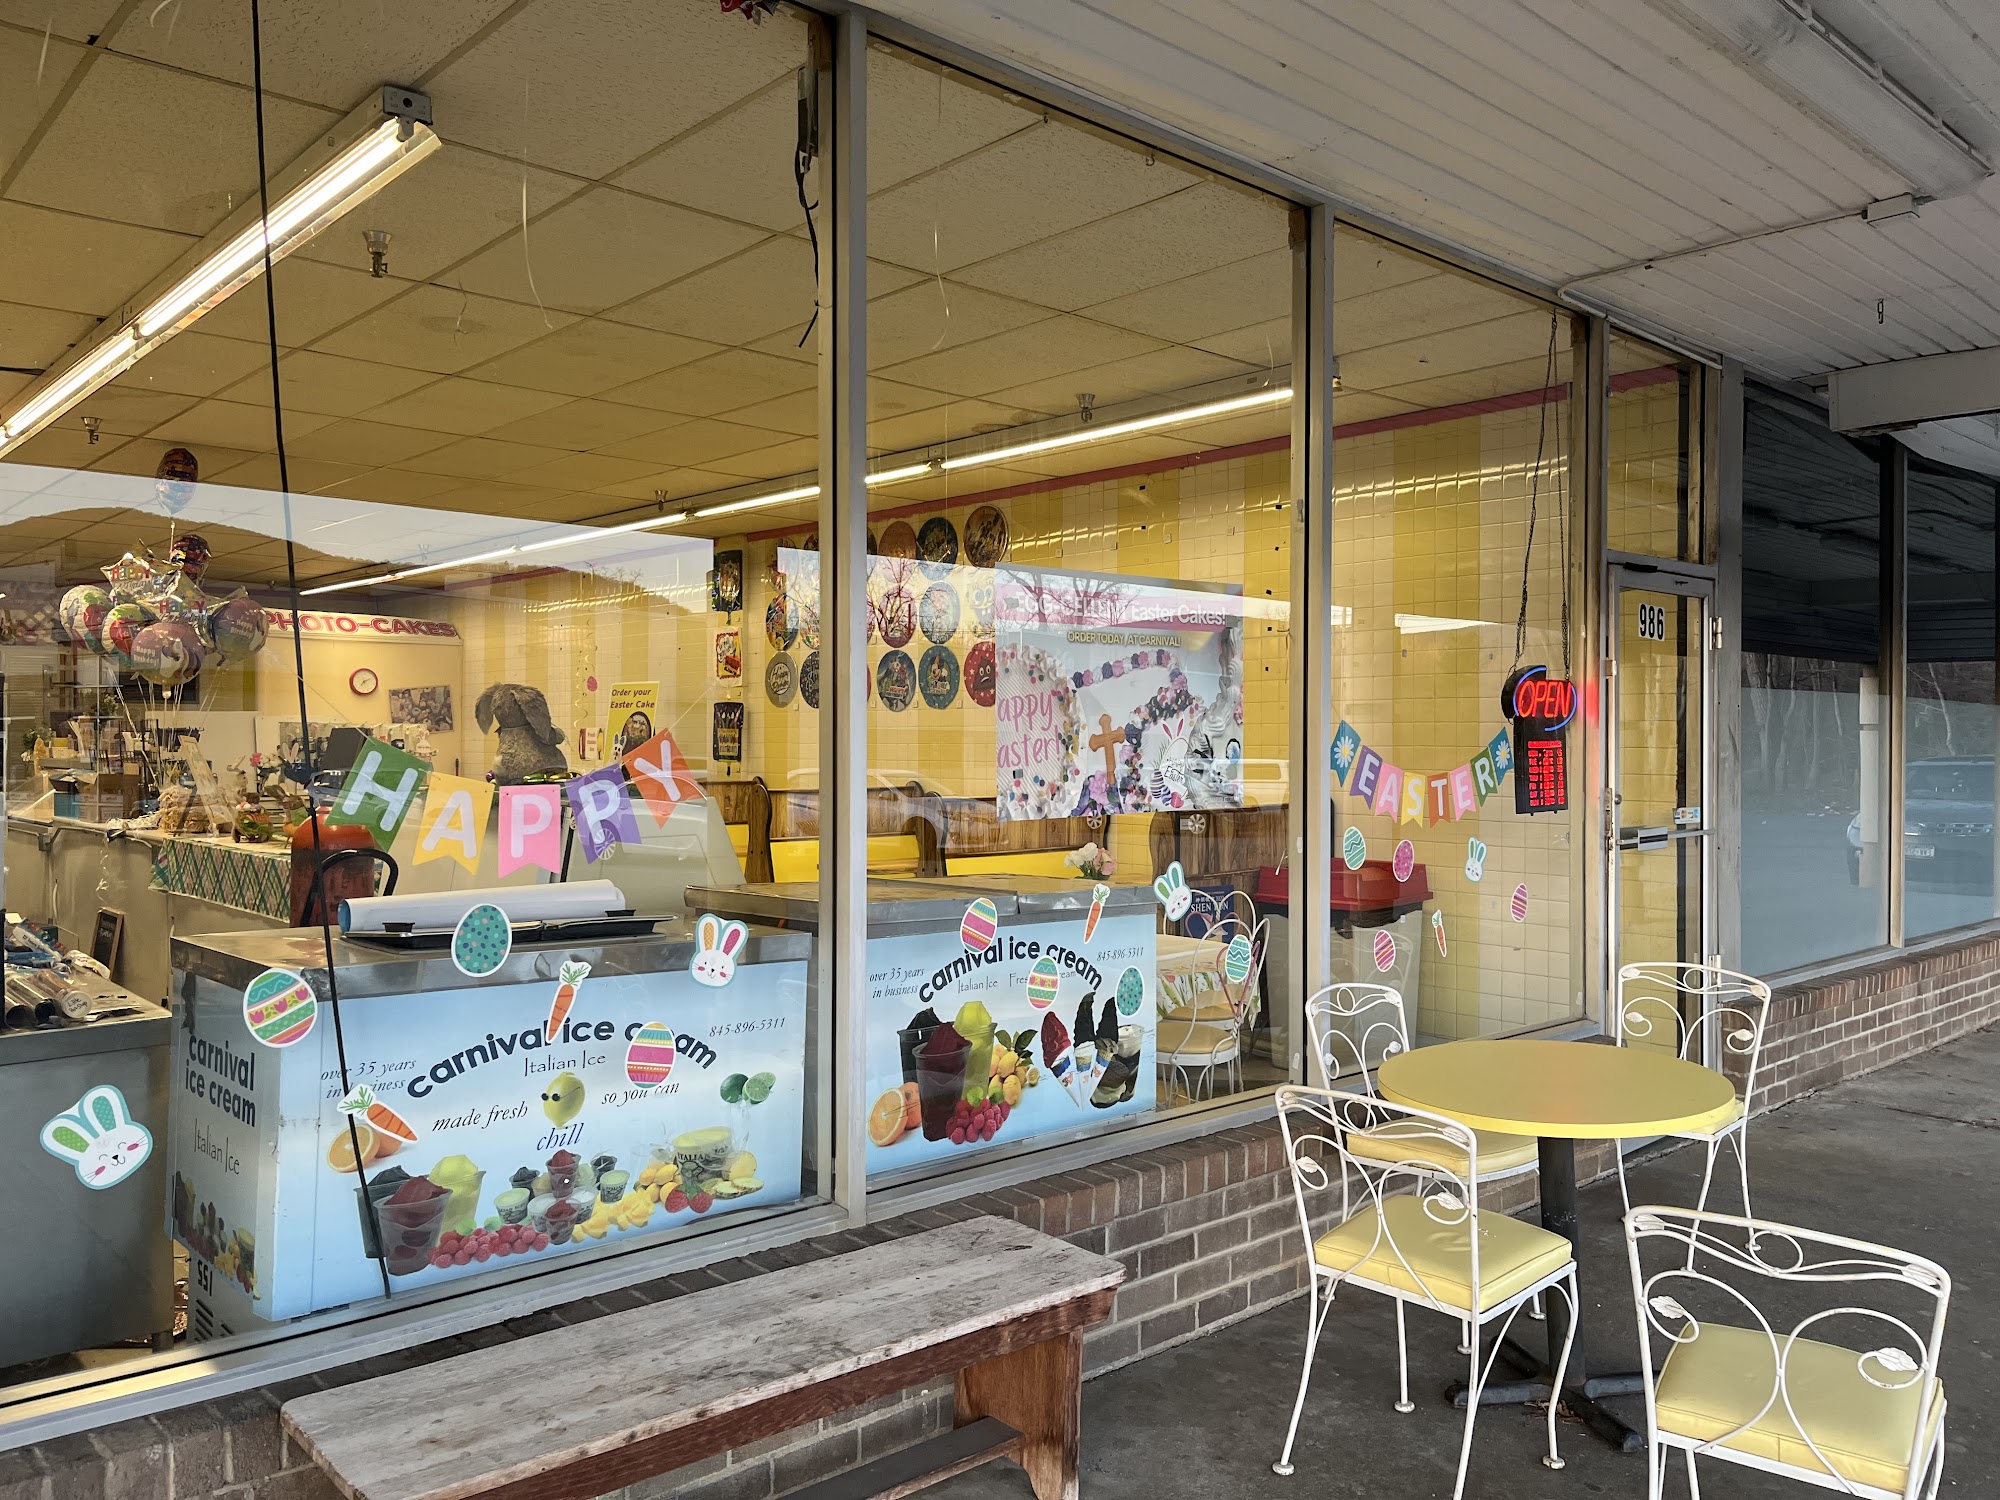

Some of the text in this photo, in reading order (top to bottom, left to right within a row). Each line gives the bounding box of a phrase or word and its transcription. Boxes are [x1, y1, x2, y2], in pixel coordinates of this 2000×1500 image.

[266, 610, 457, 638] PHOTO-CAKES
[1131, 603, 1176, 623] Easter
[1177, 604, 1227, 626] Cakes!
[1639, 603, 1665, 639] 986
[1067, 630, 1182, 647] ORDER TODAY, AT CARNIVAL!
[610, 701, 655, 709] Easter Cake
[611, 689, 652, 700] Order your
[1518, 680, 1573, 718] OPEN
[341, 739, 682, 858] HAPPY
[1358, 753, 1495, 817] EASTER
[1190, 902, 1212, 913] SHEN
[1096, 946, 1144, 962] 845-896-5311
[869, 967, 925, 983] over 35 years
[919, 935, 1103, 1003] carnival ice cream
[958, 970, 1077, 994] Italian Ice Fres ream
[872, 983, 919, 999] in business
[709, 1016, 786, 1038] 845-896-5311
[562, 1017, 615, 1043] ice
[624, 1022, 717, 1070] cam
[189, 1033, 255, 1091] carnival
[320, 1060, 417, 1081] over 35 years
[524, 1050, 606, 1077] Italian Ice
[185, 1058, 256, 1127] ice cream
[326, 1085, 342, 1099] in
[432, 1081, 680, 1132] made fresh so you can
[194, 1117, 240, 1175] Italian Ice
[536, 1122, 585, 1151] chill
